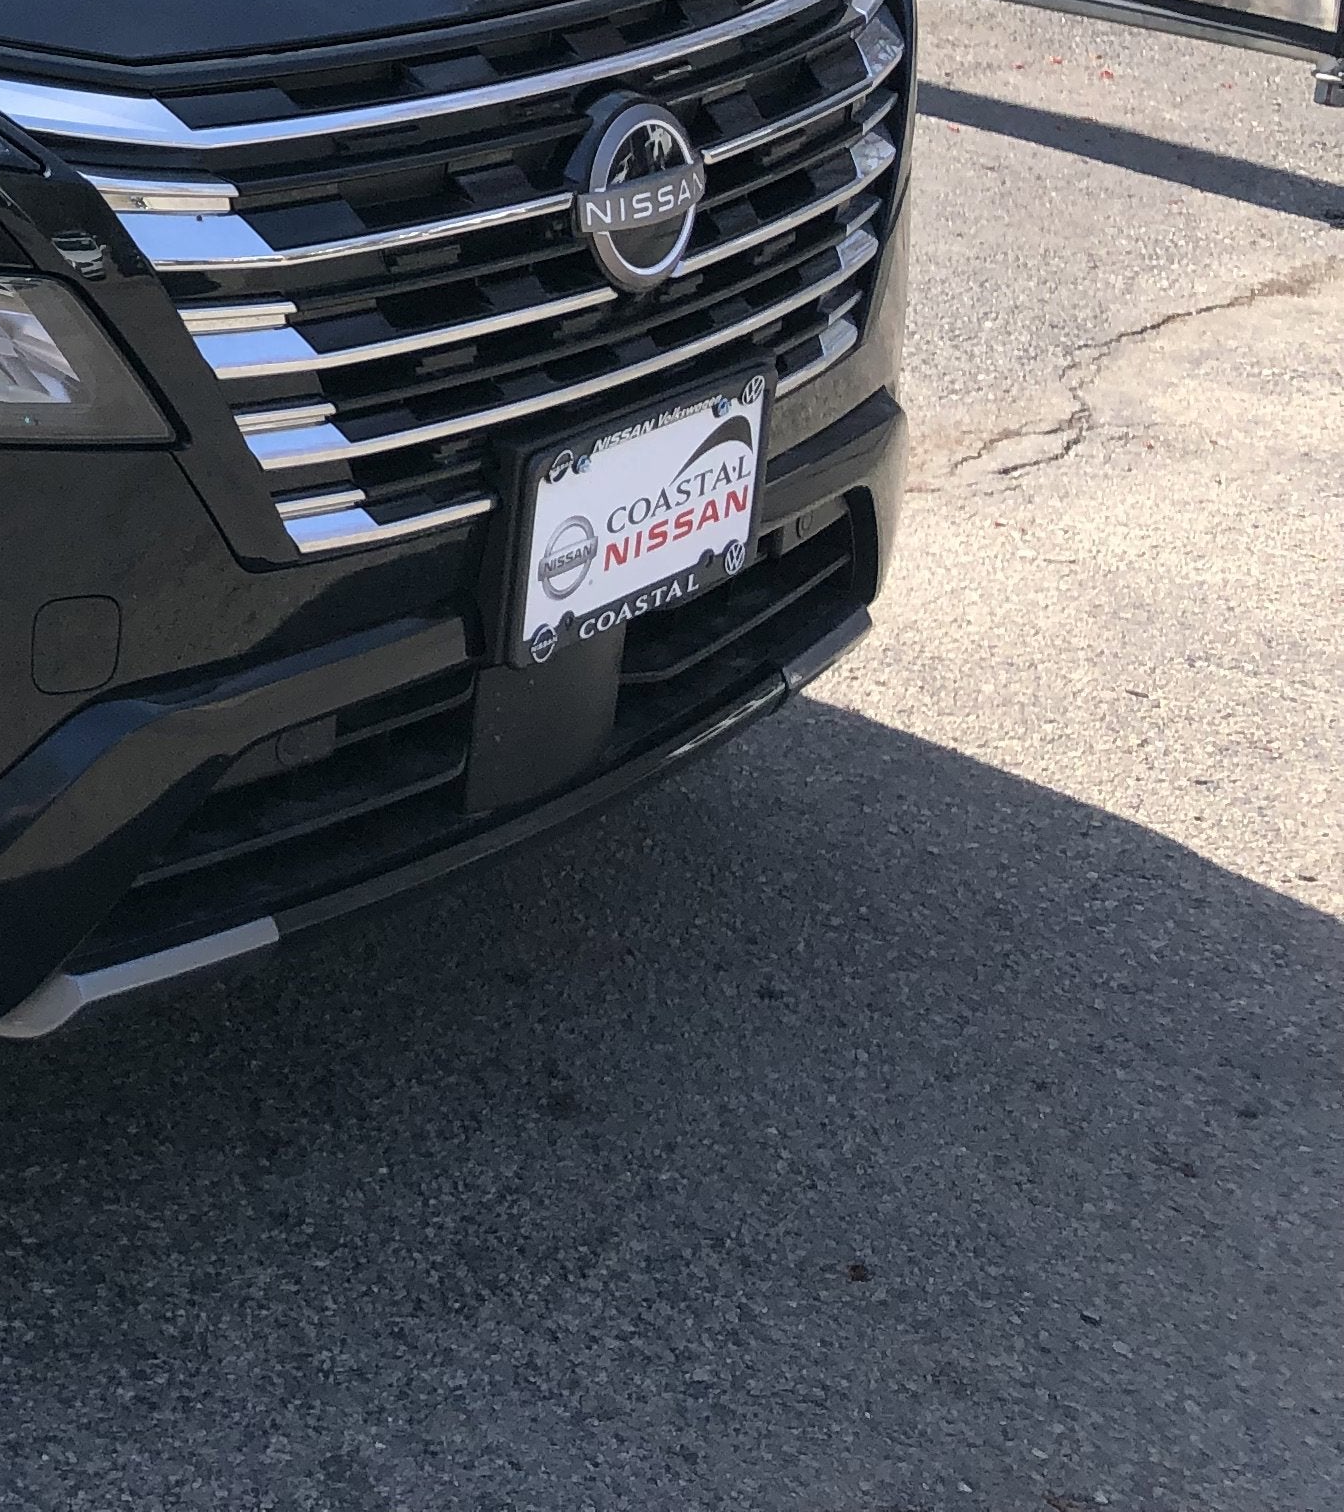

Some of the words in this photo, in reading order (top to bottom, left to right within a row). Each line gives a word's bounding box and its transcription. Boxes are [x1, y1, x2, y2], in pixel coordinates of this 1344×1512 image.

[586, 172, 704, 226] NISSAN
[592, 418, 656, 454] NISSAN
[606, 454, 752, 534] COASTAL
[603, 484, 749, 572] NISSAN
[543, 542, 593, 575] NISSAN
[579, 573, 700, 640] COASTAL
